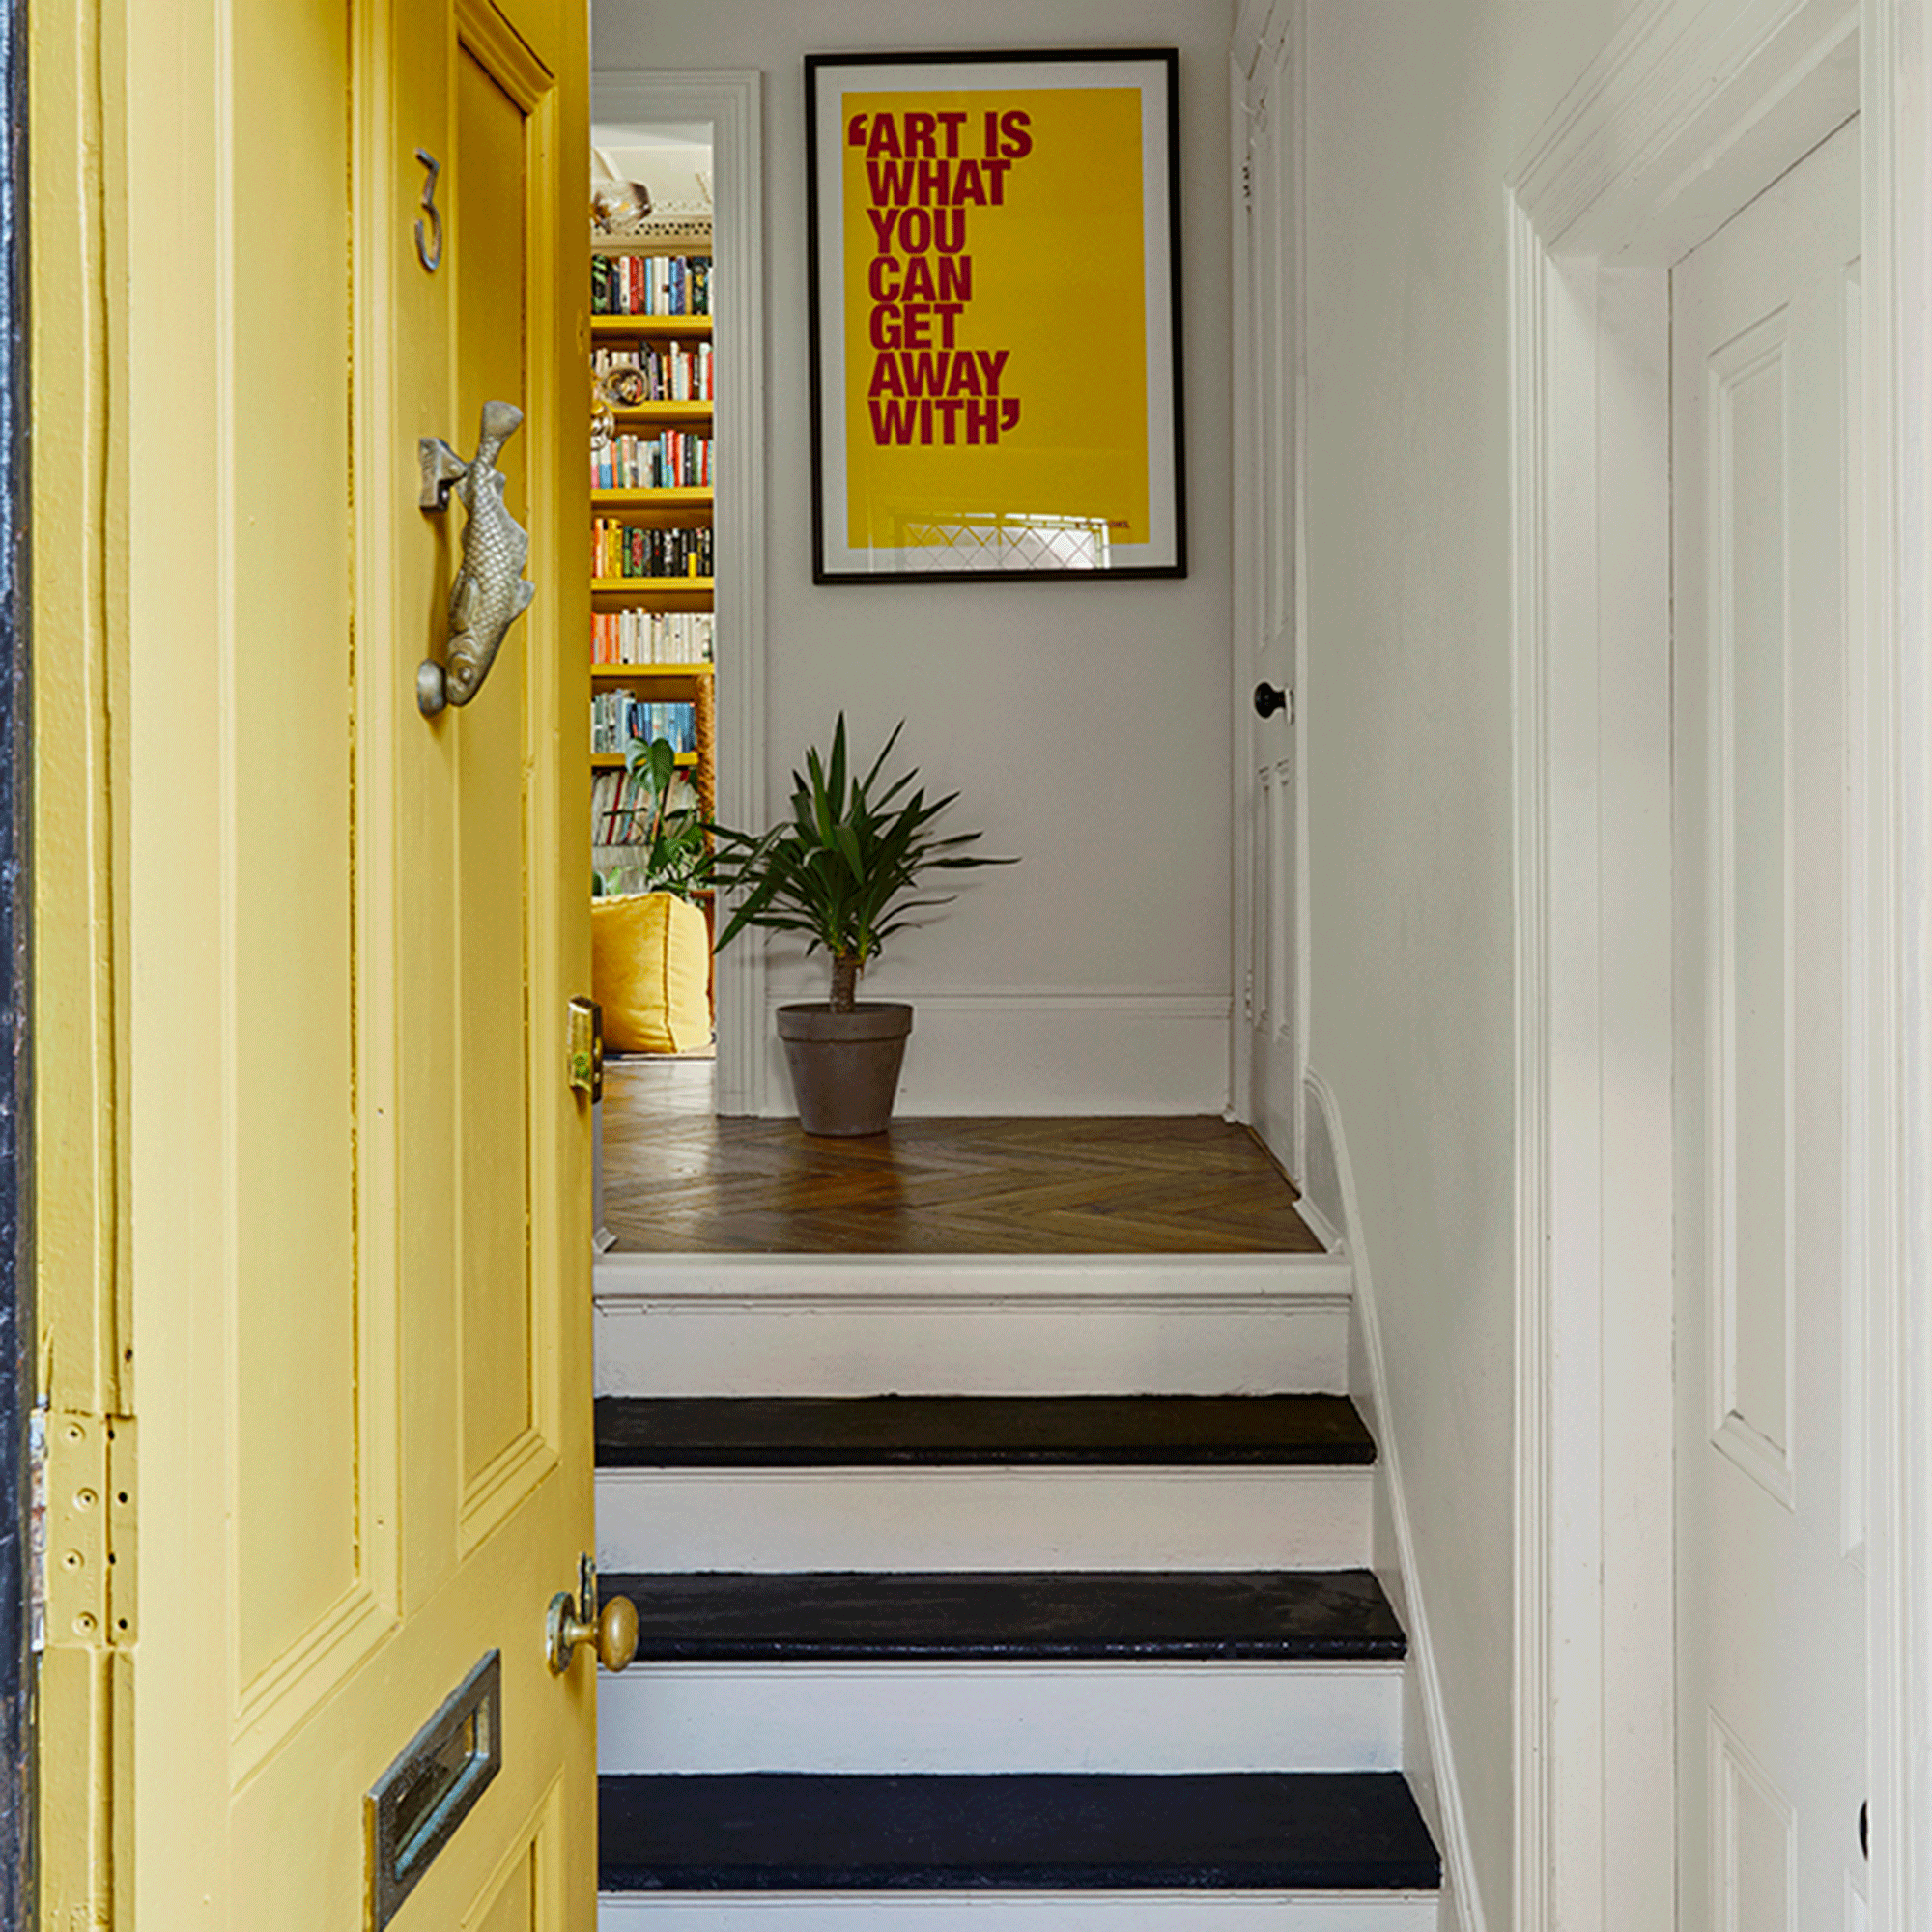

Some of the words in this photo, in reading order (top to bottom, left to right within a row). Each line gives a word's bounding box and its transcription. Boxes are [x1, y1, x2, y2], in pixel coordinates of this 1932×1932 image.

[847, 112, 967, 158] ‘ART
[985, 110, 1033, 158] IS
[866, 158, 1011, 206] WHAT
[413, 147, 442, 272] 3
[867, 208, 967, 254] YOU
[867, 255, 972, 302] CAN
[868, 303, 963, 350] GET
[867, 350, 1009, 397] AWAY
[867, 397, 1021, 446] WITH’
